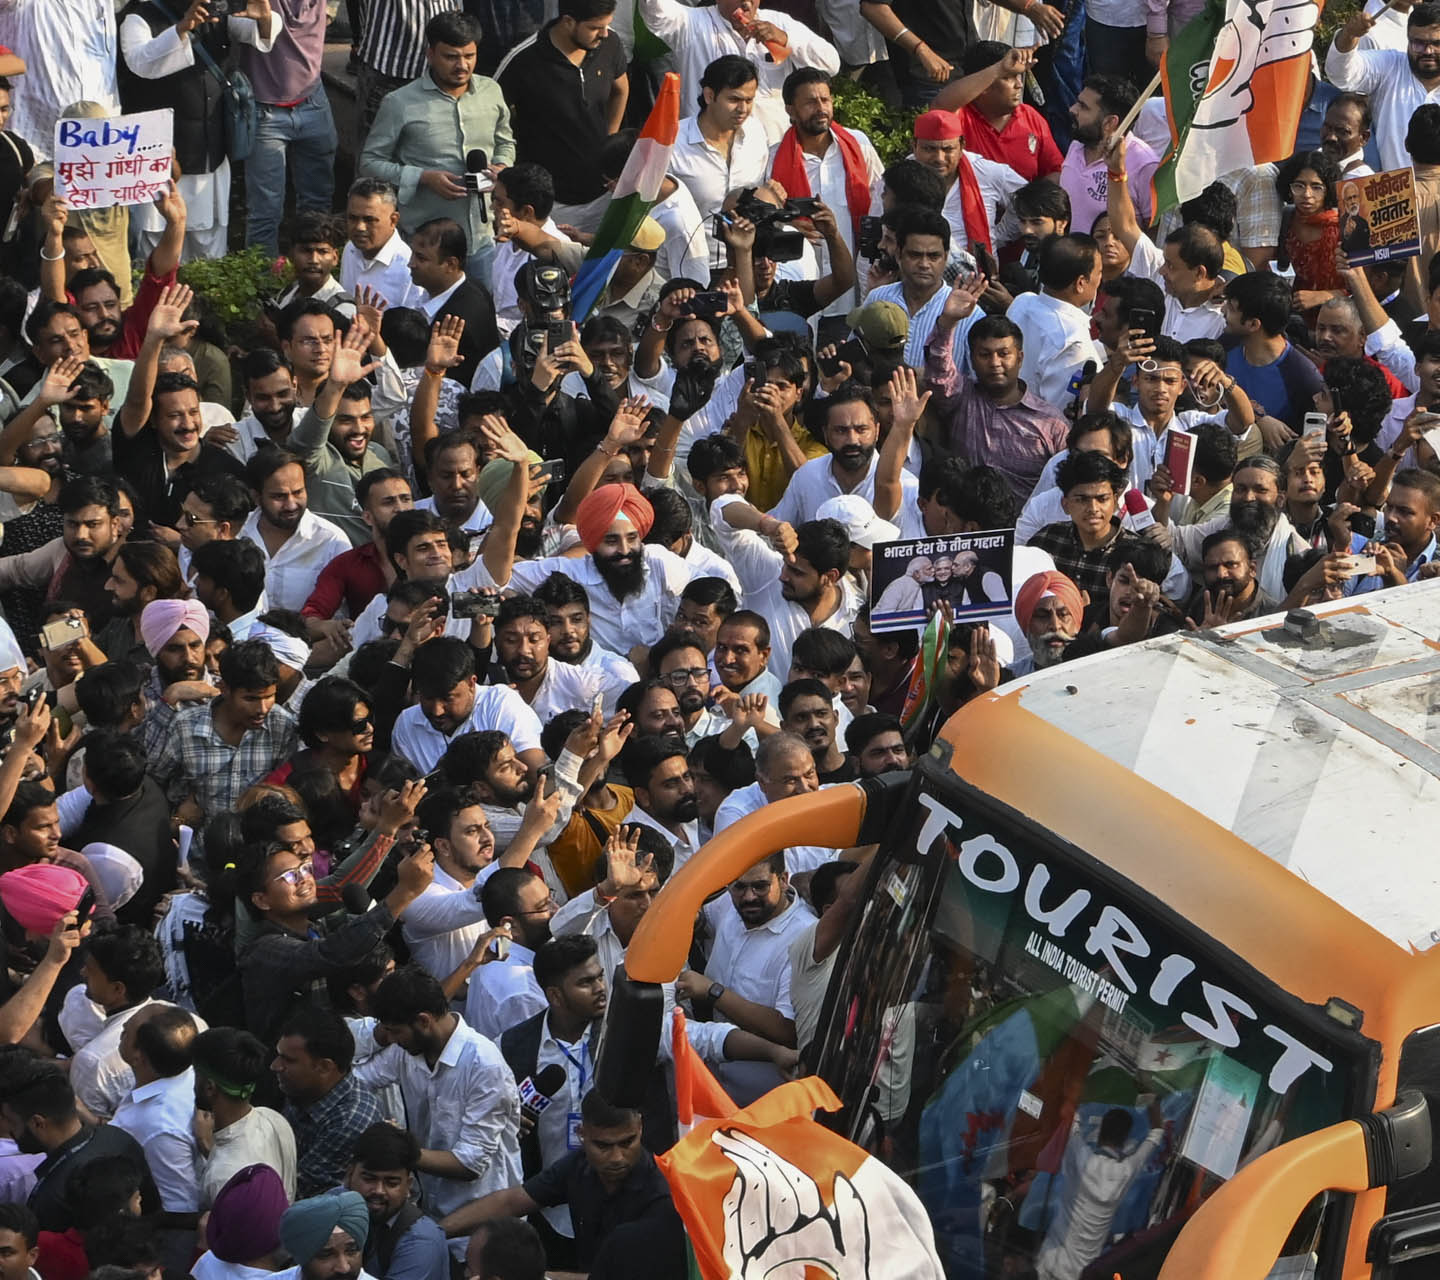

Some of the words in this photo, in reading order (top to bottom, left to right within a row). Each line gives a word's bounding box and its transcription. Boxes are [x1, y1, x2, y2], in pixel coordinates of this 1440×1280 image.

[58, 155, 100, 185] मुझे
[1374, 248, 1391, 262] NSUI
[884, 546, 913, 559] भारत
[915, 542, 935, 556] देश
[936, 539, 947, 553] के
[949, 537, 971, 552] तीन
[973, 535, 1005, 551] गद्दार!
[917, 792, 1333, 1096] TOURIST
[1025, 931, 1042, 958] ALL
[1040, 940, 1064, 973] INDIA
[1059, 952, 1098, 993] TOURIST
[1094, 980, 1130, 1015] PERMIT
